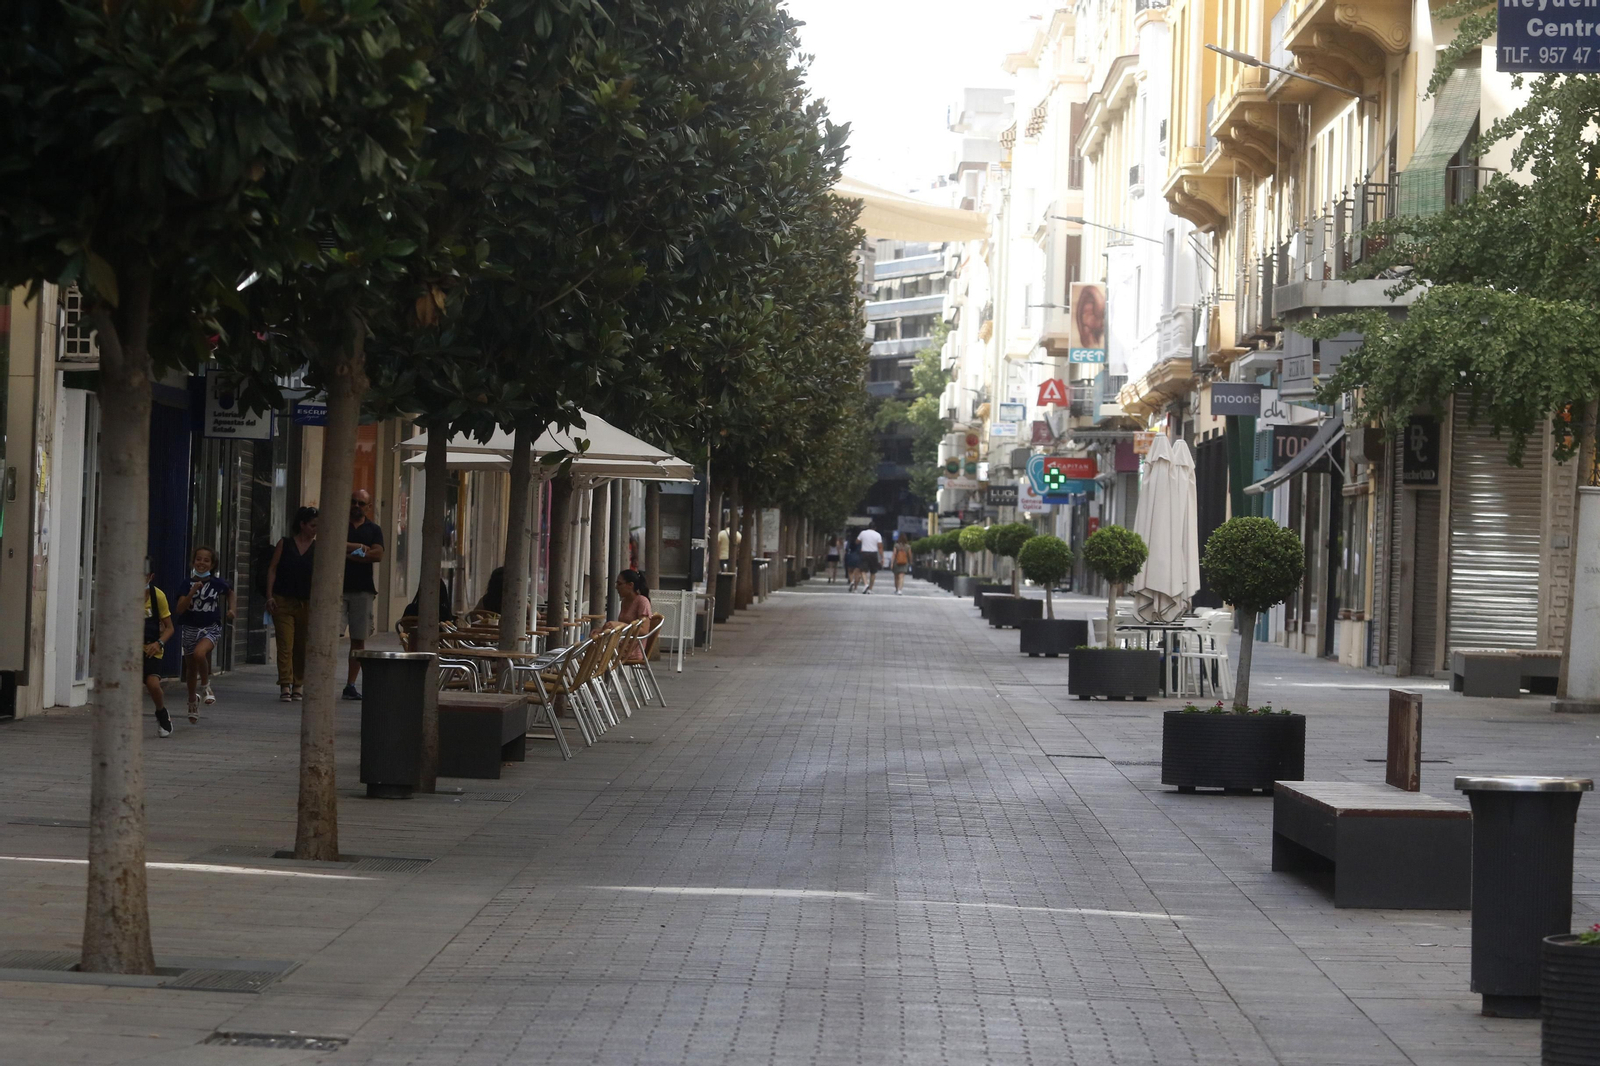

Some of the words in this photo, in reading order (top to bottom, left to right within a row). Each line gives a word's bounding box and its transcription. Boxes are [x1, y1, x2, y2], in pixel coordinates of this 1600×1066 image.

[1502, 46, 1532, 63] TLF.
[1539, 46, 1567, 64] 957
[1573, 46, 1592, 64] 47
[1214, 393, 1260, 404] moonë
